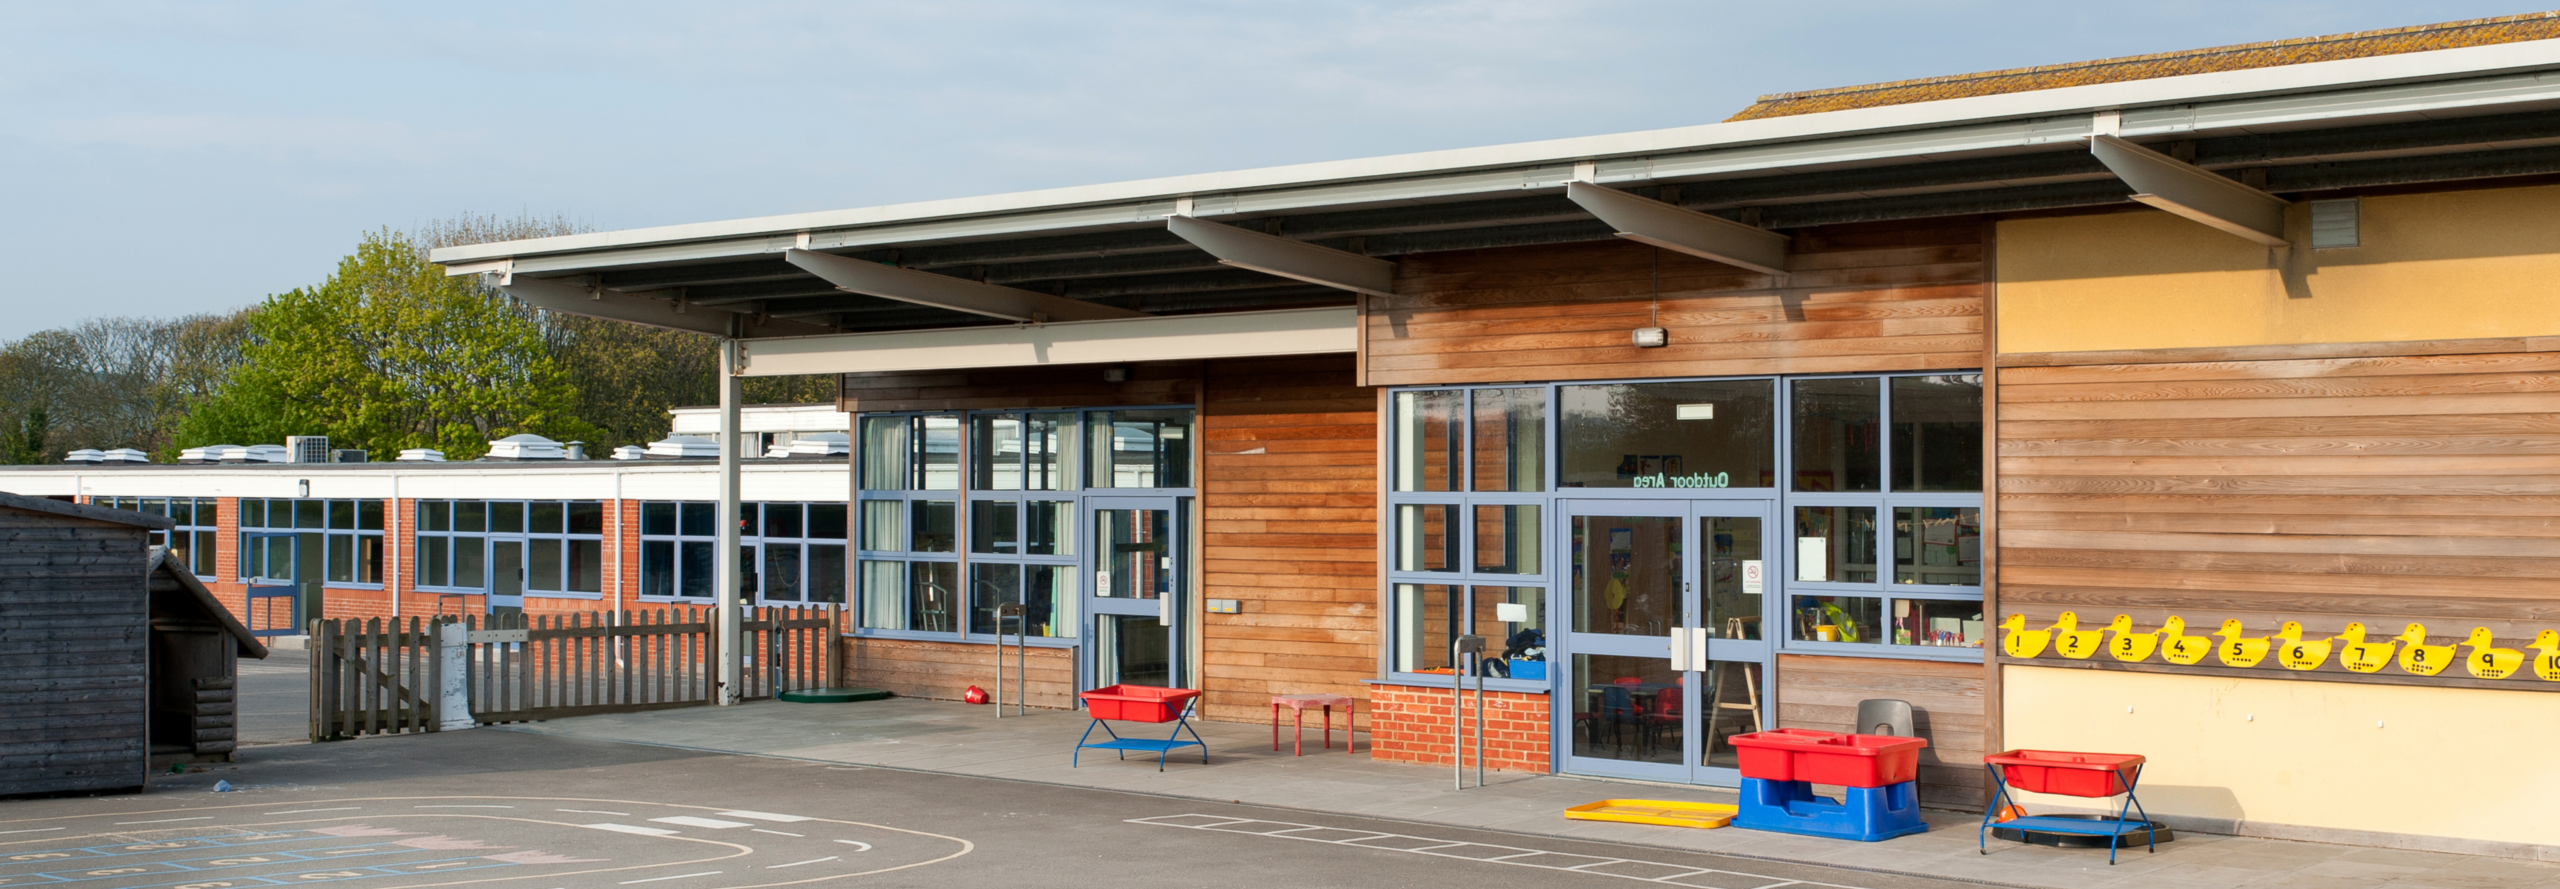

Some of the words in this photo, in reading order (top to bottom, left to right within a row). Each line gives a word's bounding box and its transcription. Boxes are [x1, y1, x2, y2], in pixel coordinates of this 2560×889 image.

[2068, 635, 2079, 648] 2
[2122, 637, 2133, 651] 3
[2174, 639, 2186, 653] 4
[2232, 642, 2243, 656] 5
[2292, 646, 2304, 660] 6
[2354, 647, 2366, 661] 7
[2413, 648, 2426, 662] 8
[2482, 653, 2494, 668] 9
[86, 867, 147, 876] 3
[298, 870, 363, 880] 2
